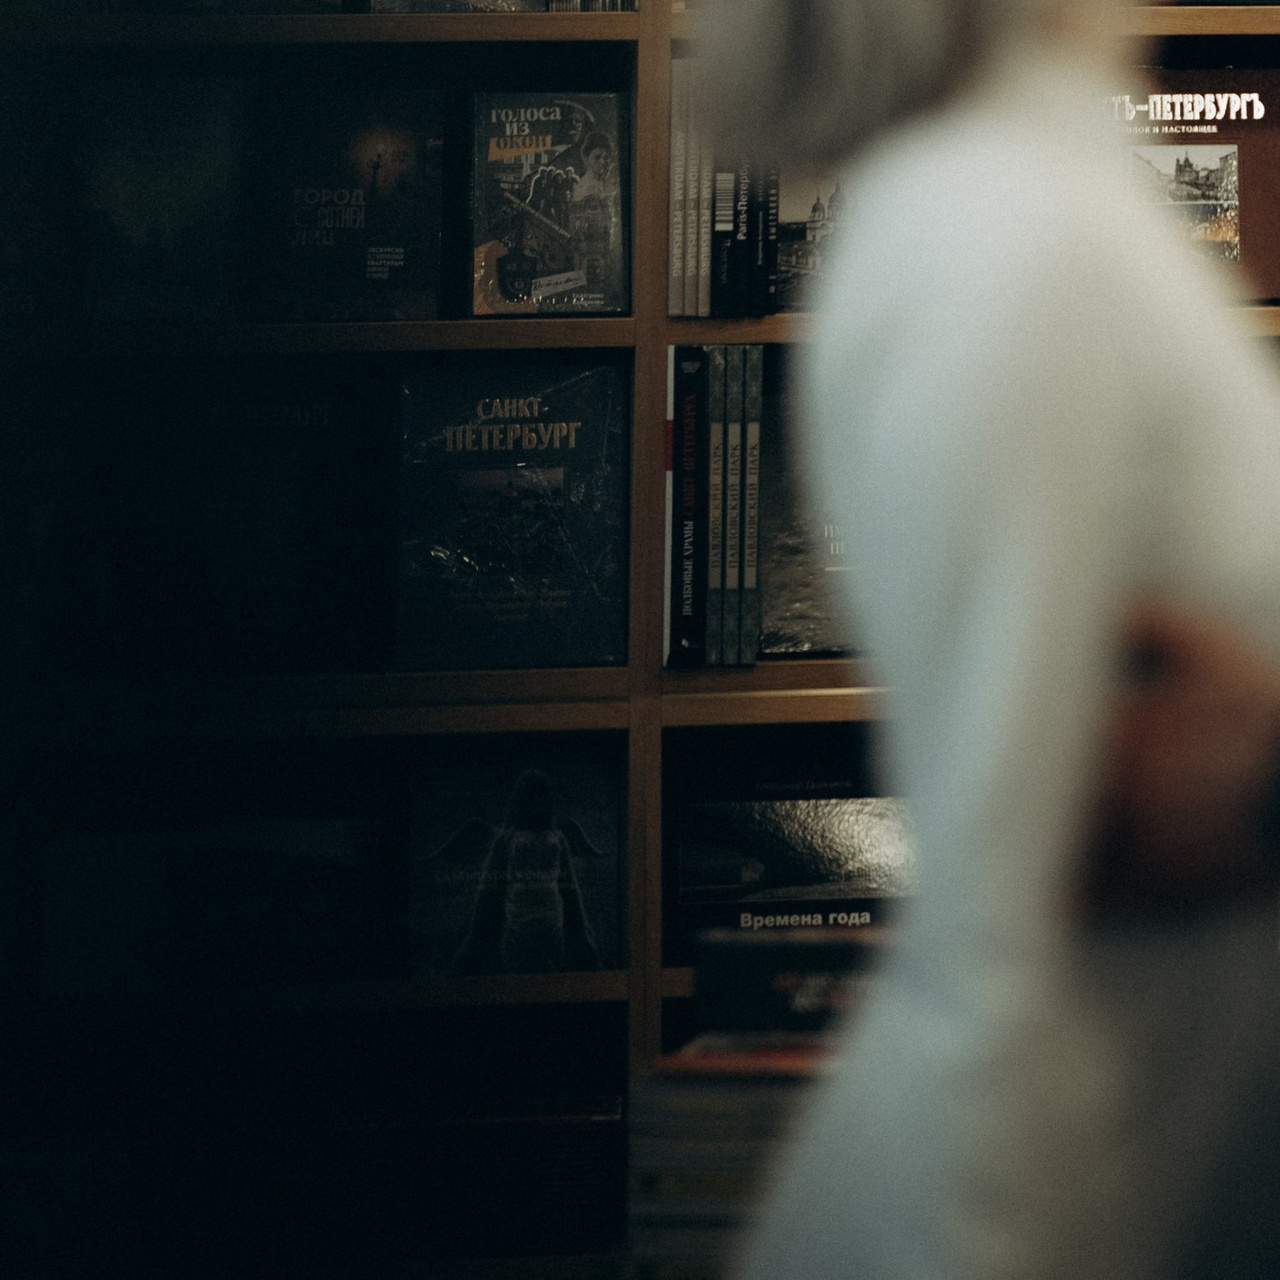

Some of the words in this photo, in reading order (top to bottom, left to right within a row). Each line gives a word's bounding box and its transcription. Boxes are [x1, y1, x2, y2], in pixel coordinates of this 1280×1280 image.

[476, 396, 549, 420] САНКТ-
[445, 421, 582, 452] ПЕТЕРБУРГ
[711, 442, 722, 476] ПАРК
[729, 442, 740, 476] ПАРК
[747, 442, 758, 476] ПАРК
[710, 482, 722, 569] ПАВЛОВСКИЙ
[728, 482, 740, 569] ПАВЛОВСКИЙ
[746, 482, 758, 569] ПАВЛОВСКИЙ
[739, 912, 823, 930] Времена
[828, 911, 871, 926] года
